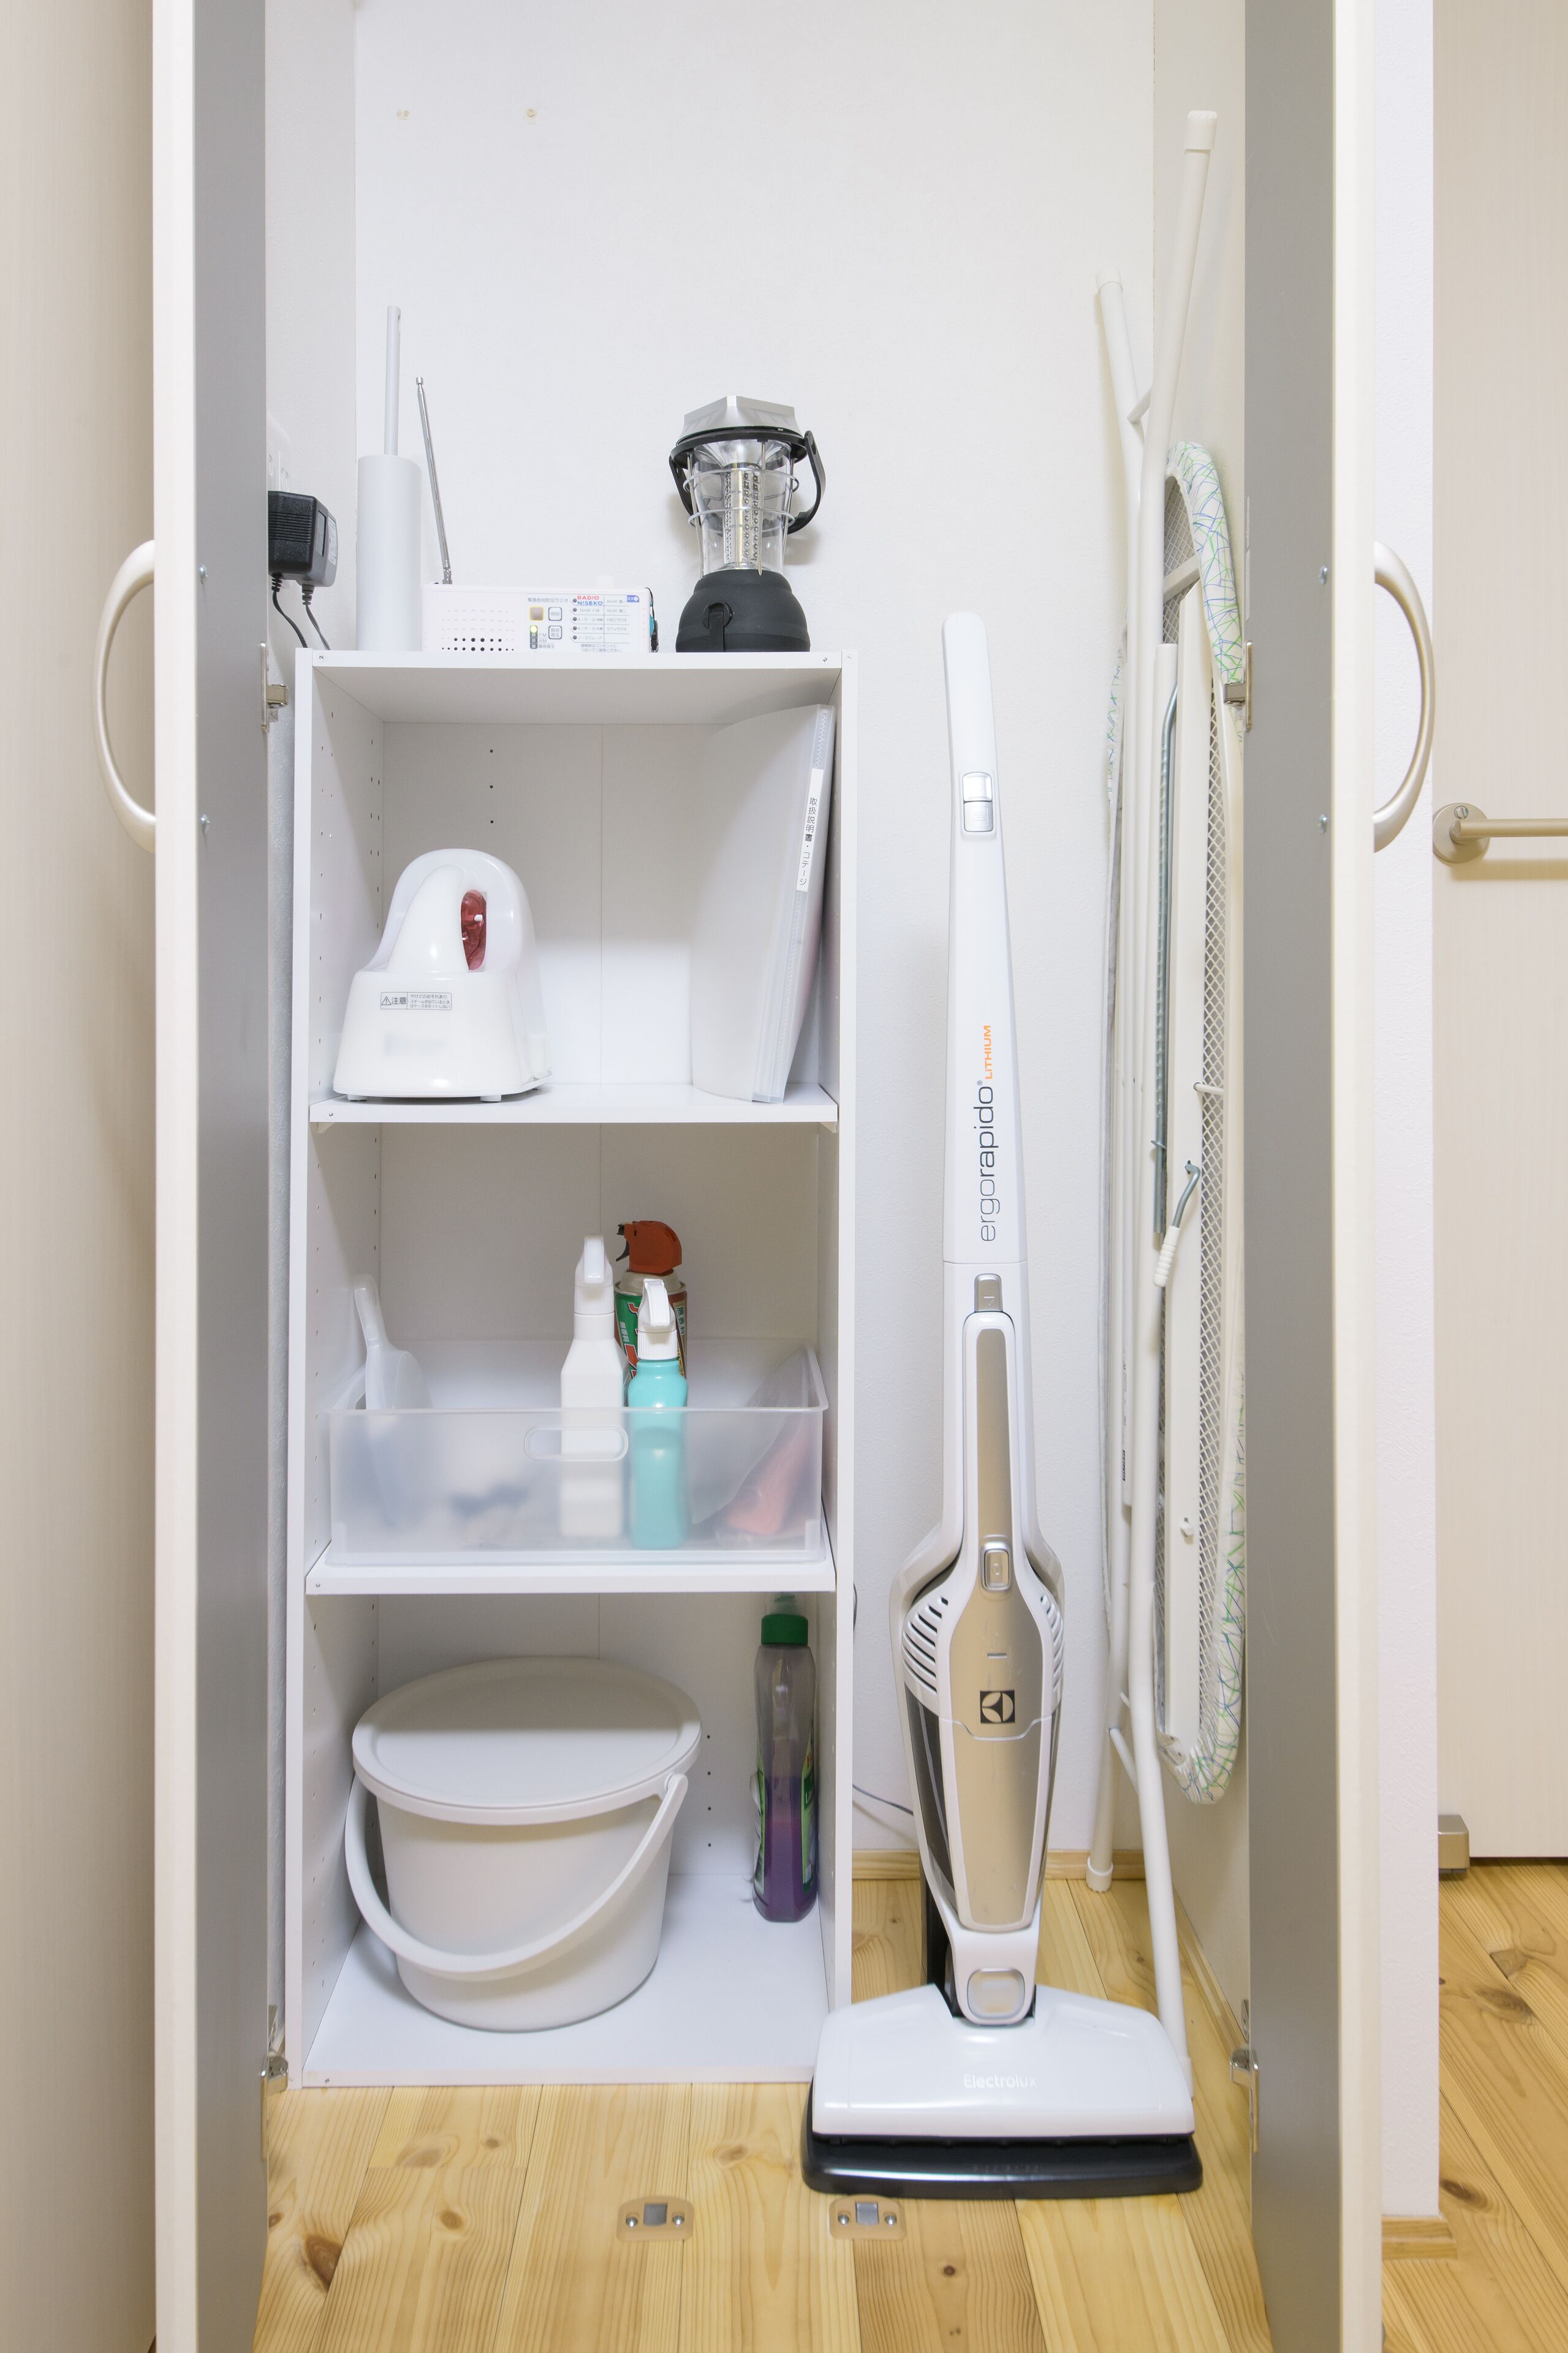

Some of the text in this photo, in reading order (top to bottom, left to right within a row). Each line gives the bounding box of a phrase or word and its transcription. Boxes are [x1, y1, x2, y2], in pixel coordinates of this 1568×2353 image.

[799, 797, 818, 886] 取扱説明書・コテージ
[391, 996, 407, 1005] 注意
[963, 2073, 1039, 2089] Electrolux
